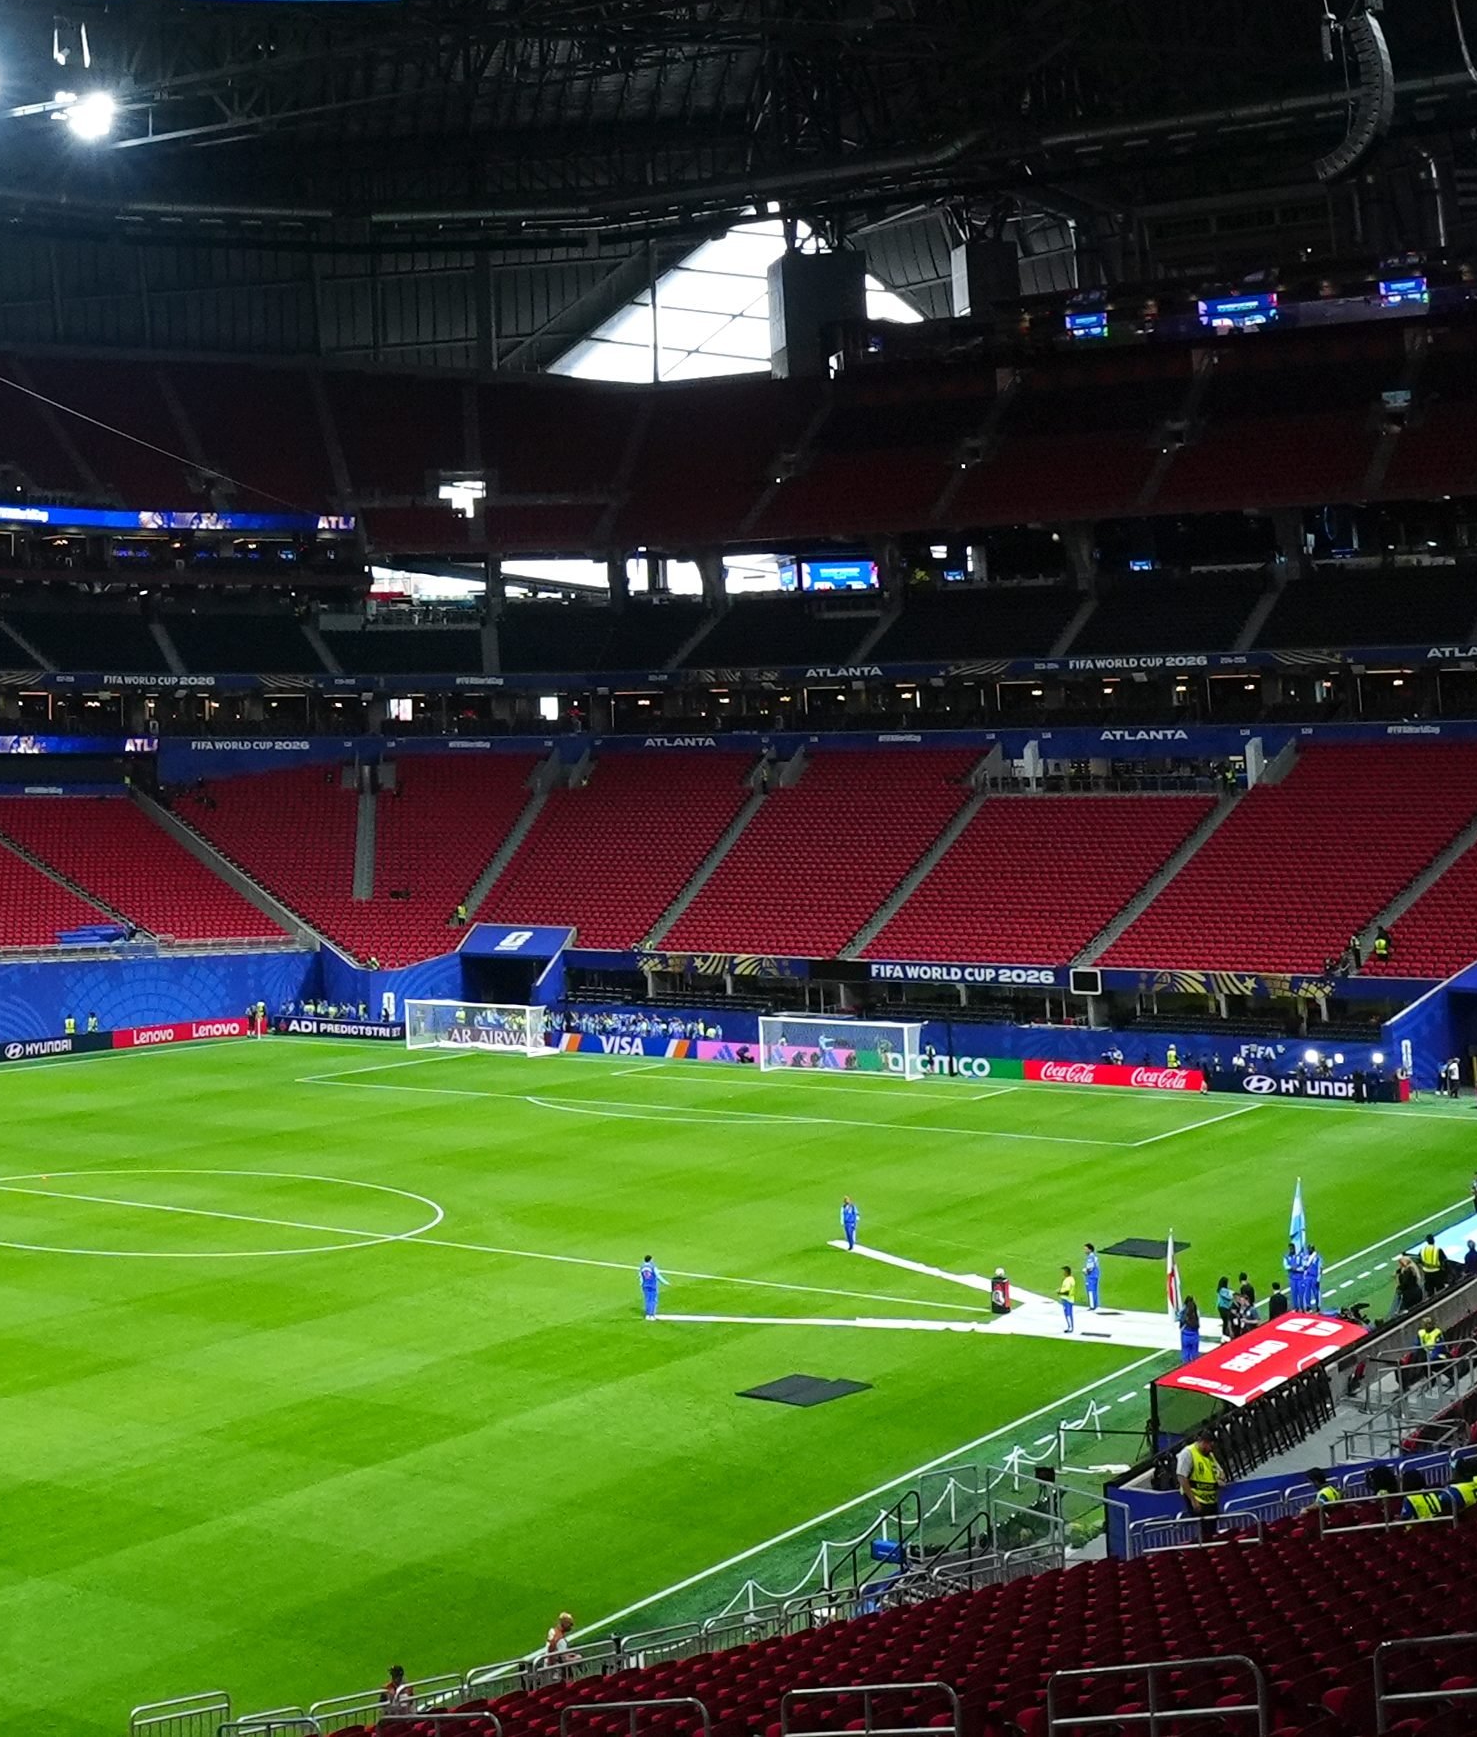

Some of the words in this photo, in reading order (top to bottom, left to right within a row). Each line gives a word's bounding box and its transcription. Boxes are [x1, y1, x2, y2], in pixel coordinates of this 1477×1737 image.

[1069, 659, 1093, 669] FIFA
[1095, 658, 1136, 669] WORLD
[1138, 657, 1163, 668] CUP
[1165, 656, 1207, 667] 2026
[805, 667, 883, 679] ATLANTA
[104, 676, 126, 686] FIFA
[128, 676, 157, 687] WORLD
[159, 676, 177, 687] CUP
[179, 676, 215, 687] 2026
[1100, 729, 1188, 740] ATLANTA
[191, 740, 214, 751] FIFA
[217, 740, 250, 751] WORLD
[252, 740, 272, 751] CUP
[274, 740, 310, 751] 2026
[644, 737, 716, 748] ATLANTA
[871, 965, 904, 979] FIFA
[907, 966, 961, 982] WORLD
[964, 968, 995, 983] CUP
[998, 969, 1054, 984] 2026
[192, 1021, 239, 1038] Lenovo
[288, 1020, 317, 1033] ADI
[133, 1028, 174, 1045] Lenovo
[25, 1038, 72, 1057] HYUNDAI
[601, 1036, 644, 1056] VISA
[1040, 1061, 1096, 1083] Coca-Cola
[1131, 1067, 1187, 1089] Coca-Cola
